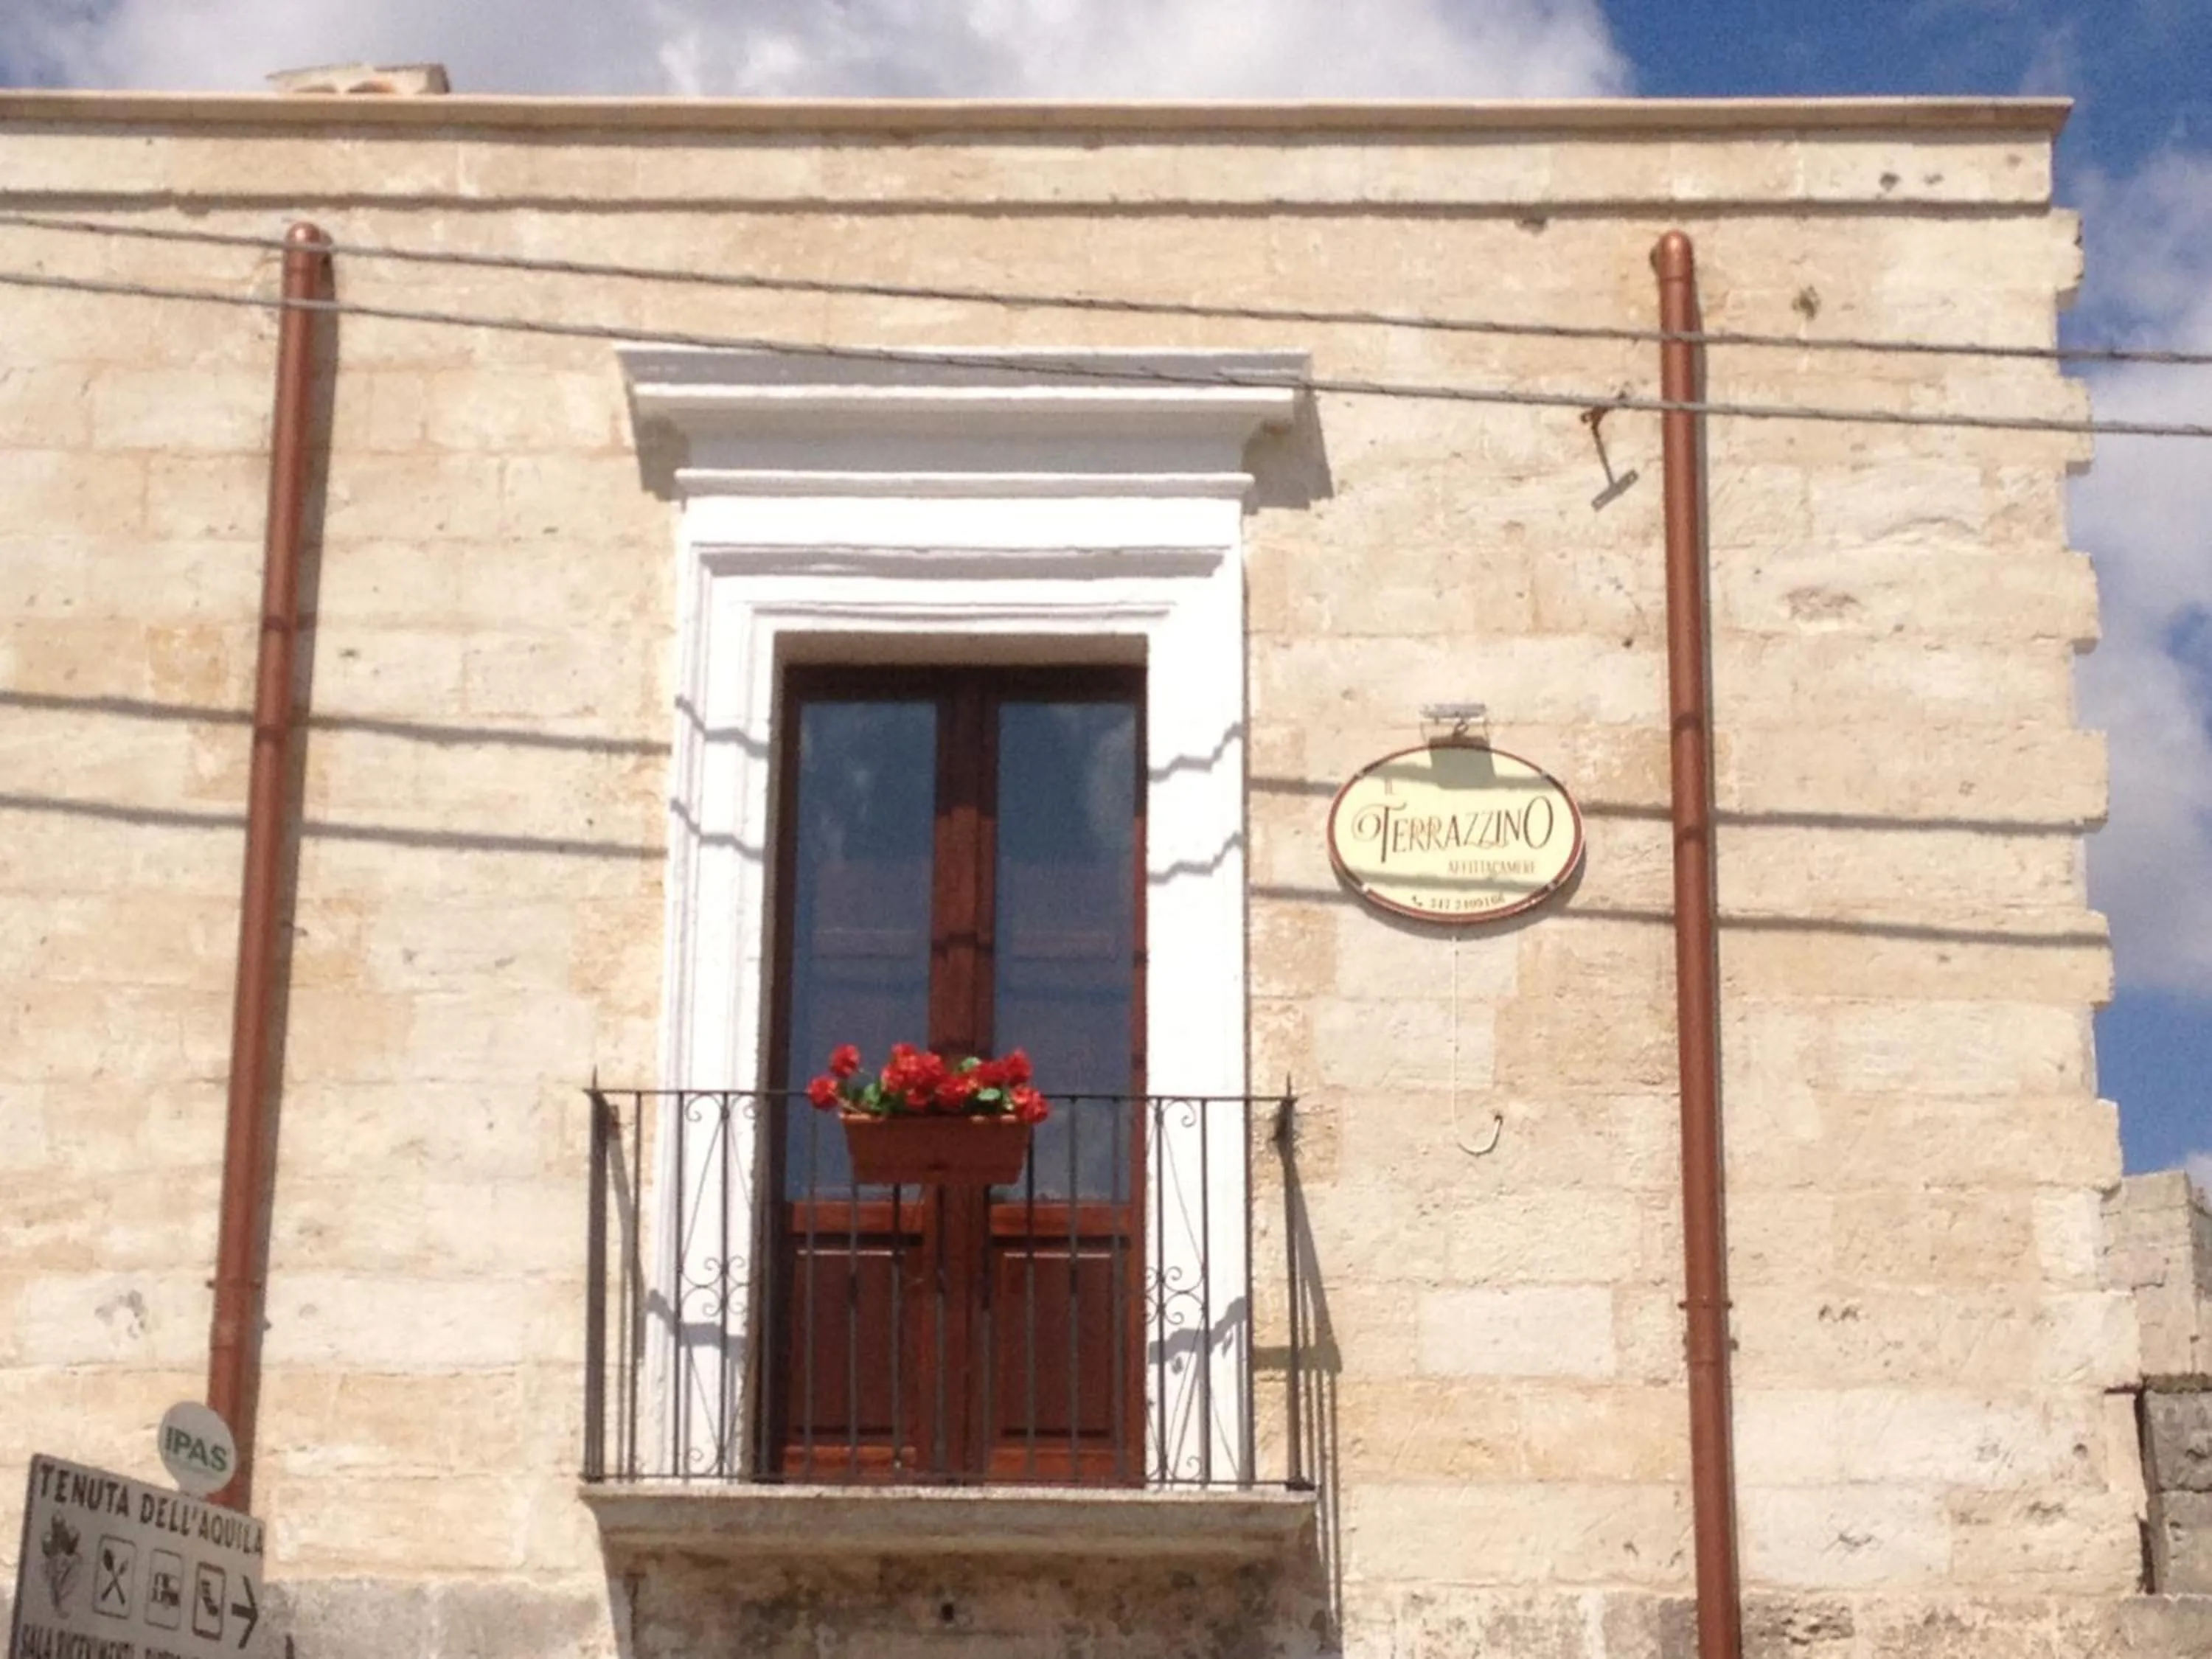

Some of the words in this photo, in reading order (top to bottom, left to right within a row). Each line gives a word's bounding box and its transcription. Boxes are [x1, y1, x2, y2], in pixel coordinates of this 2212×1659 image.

[1352, 796, 1554, 863] TERRAZZINO
[166, 1427, 228, 1473] IPAS
[39, 1464, 130, 1517] TENUTA
[140, 1493, 264, 1558] DELL'AQUILA
